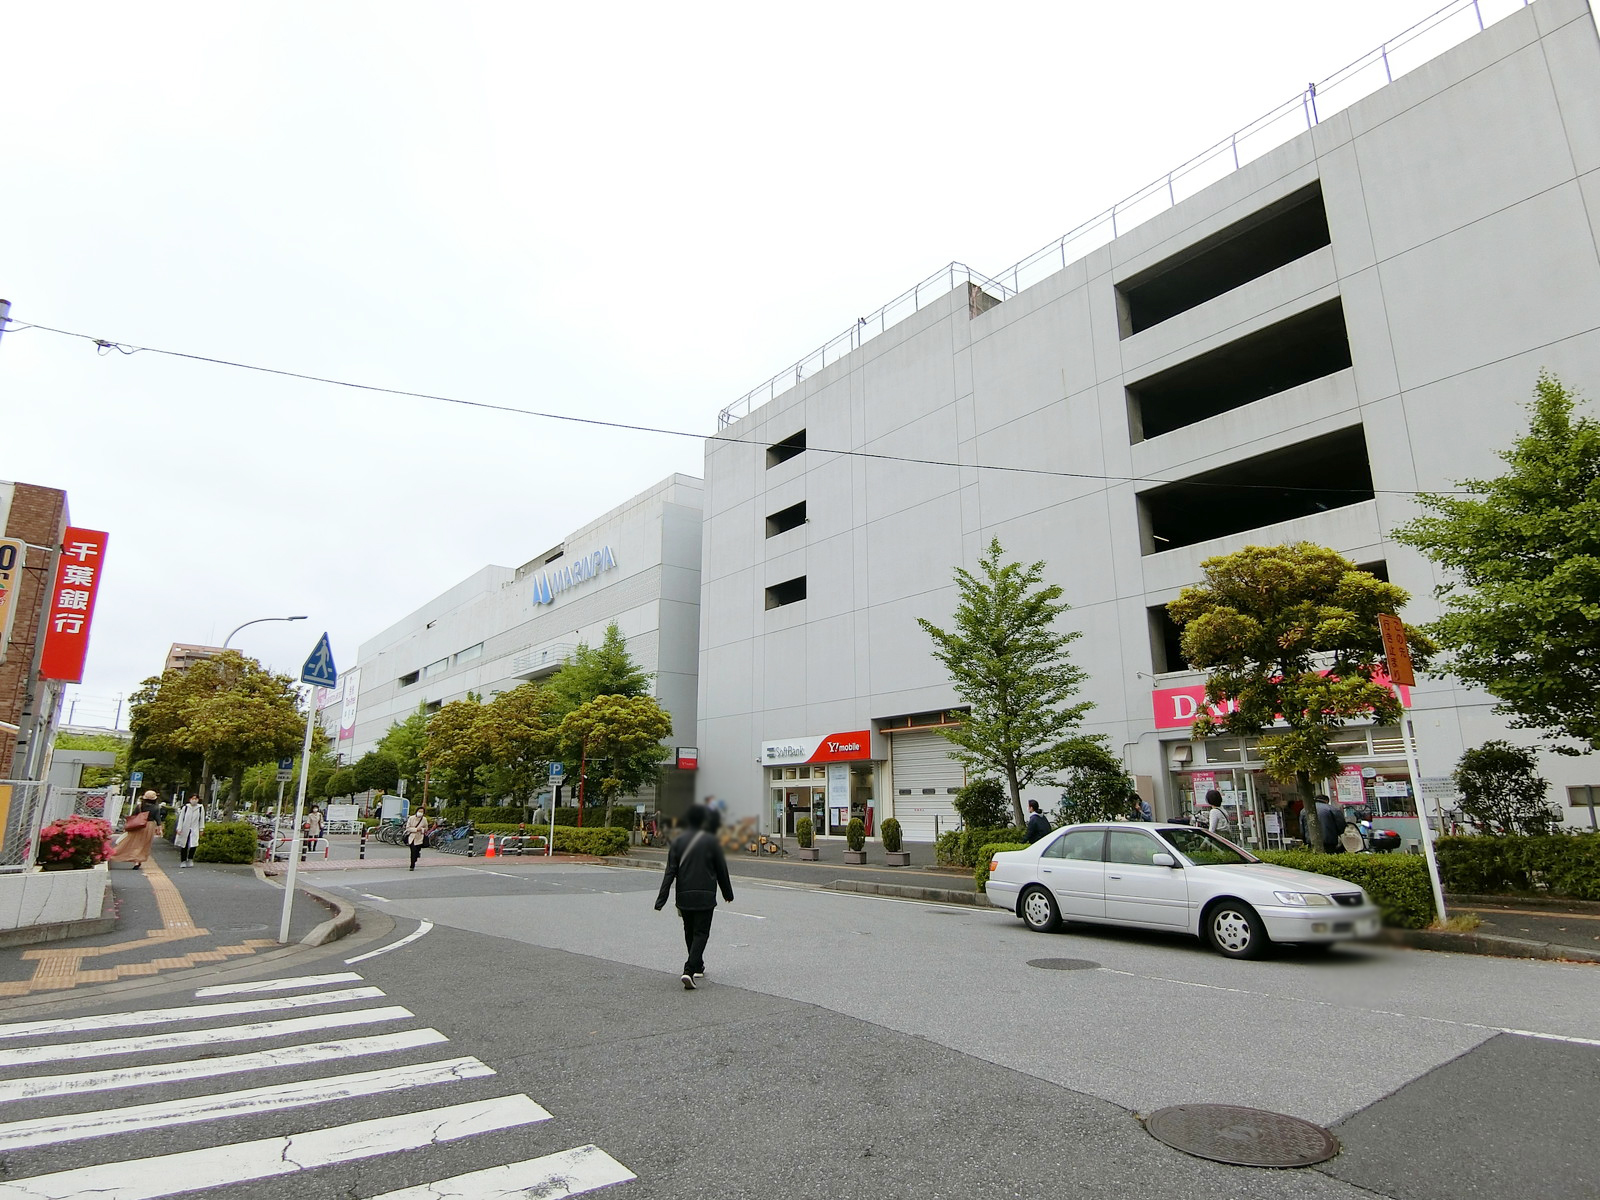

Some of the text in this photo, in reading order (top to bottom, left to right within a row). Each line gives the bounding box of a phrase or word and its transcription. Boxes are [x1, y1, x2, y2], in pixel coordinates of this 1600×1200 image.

[54, 541, 98, 634] 千葉銀行
[1383, 619, 1401, 681] 行き止まり
[552, 764, 561, 774] P
[775, 745, 805, 758] SoftBank
